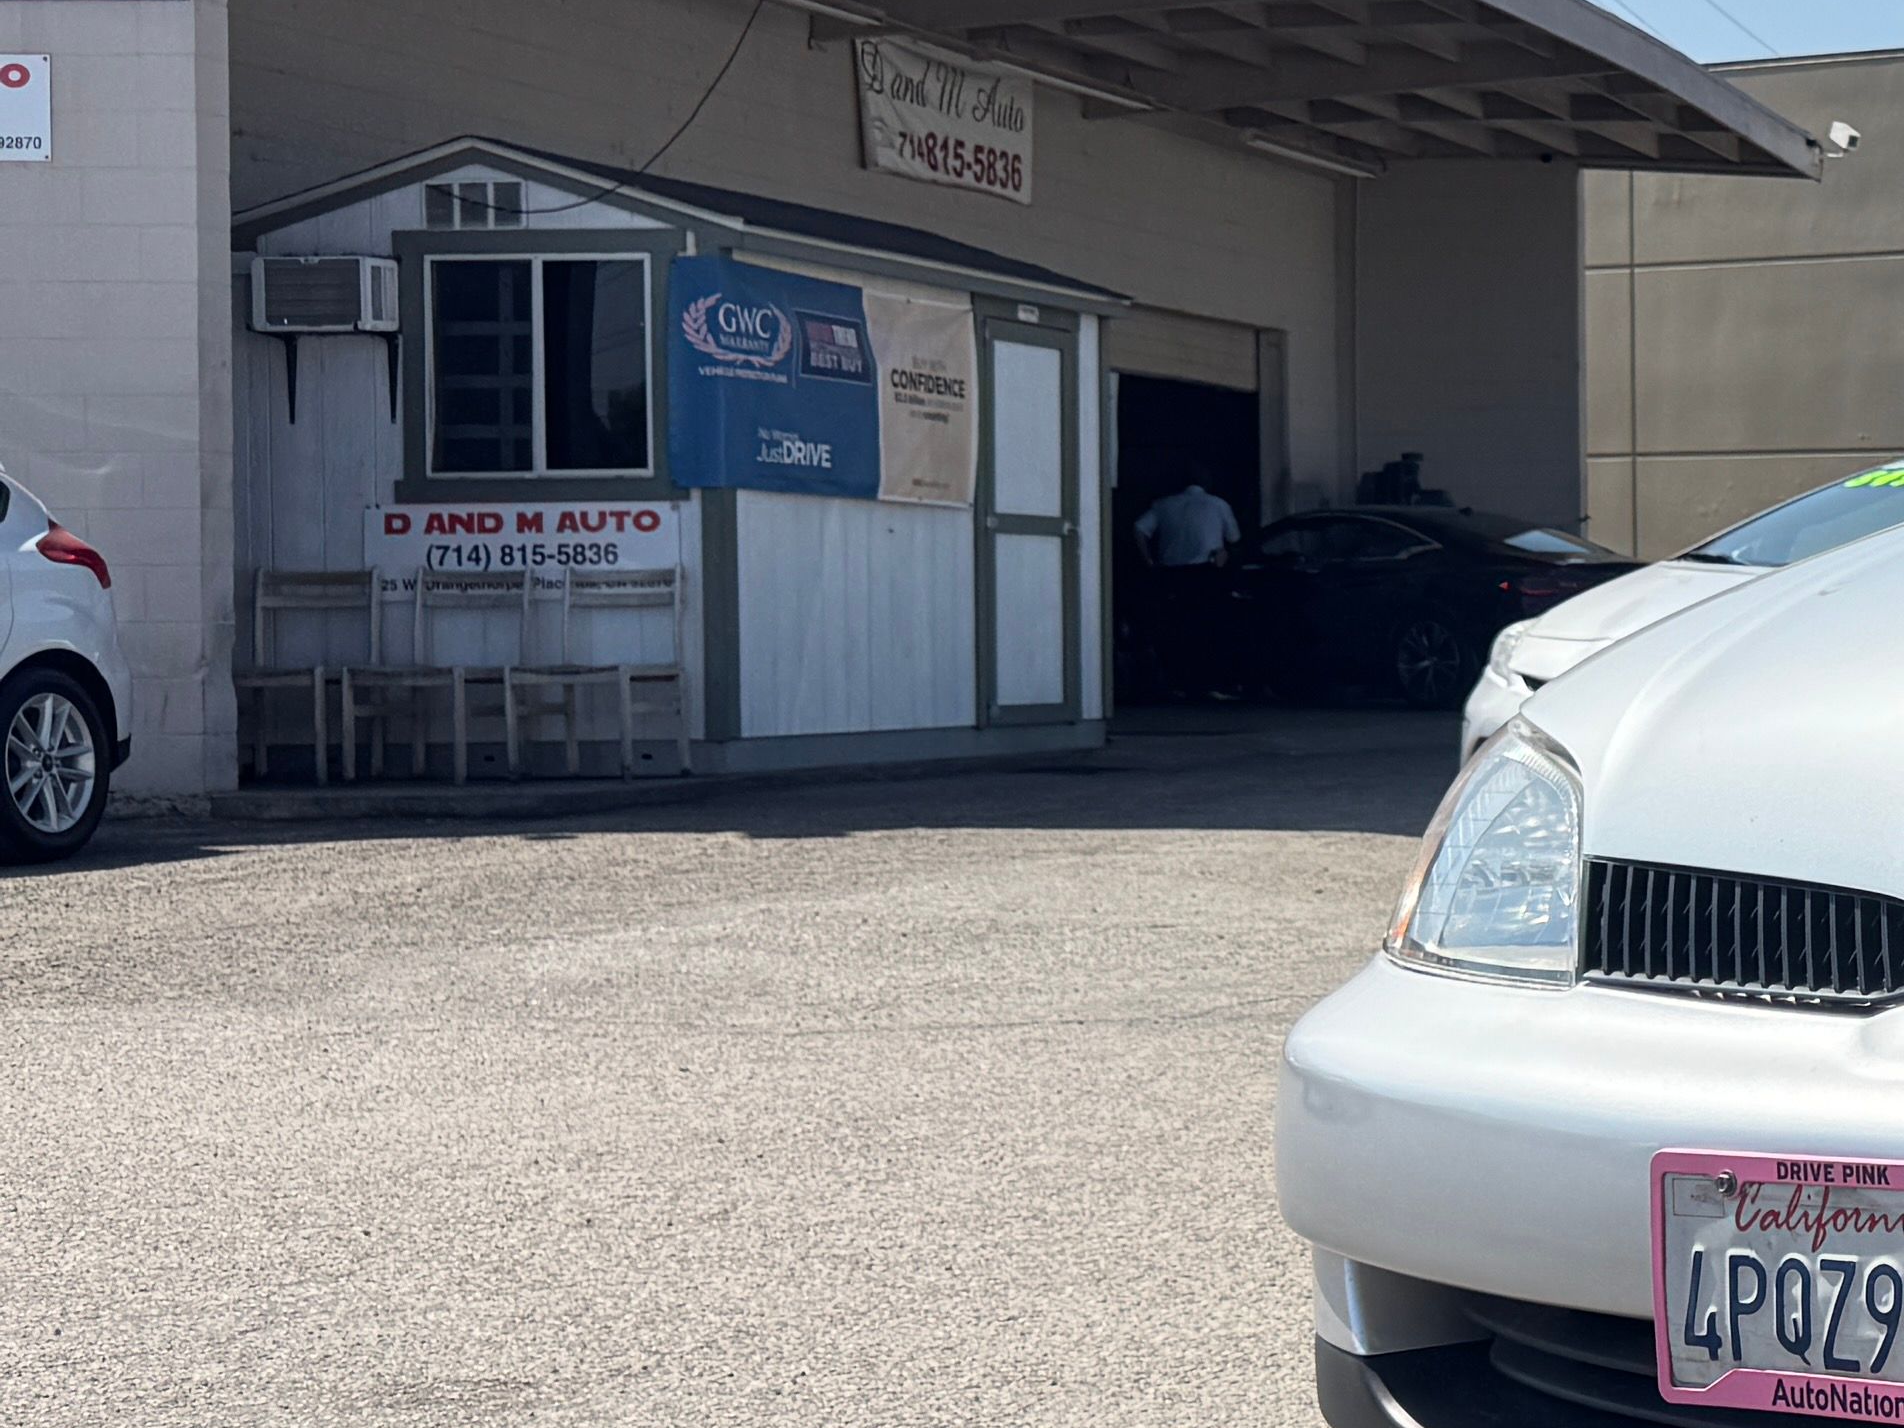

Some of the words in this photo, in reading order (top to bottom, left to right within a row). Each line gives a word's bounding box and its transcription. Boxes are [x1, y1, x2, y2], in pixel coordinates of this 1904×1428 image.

[891, 61, 931, 108] and
[937, 61, 966, 119] M
[972, 77, 1024, 132] Auto
[718, 302, 773, 339] GWC
[890, 368, 966, 399] CONFIDENCE
[384, 514, 411, 535] D
[424, 512, 504, 535] AND
[516, 511, 544, 534] M
[556, 510, 662, 533] AUTO
[426, 543, 491, 571] (714)
[500, 543, 619, 567] 815-5836
[1776, 1160, 1835, 1184] DRIVE
[1842, 1164, 1891, 1186] PINK
